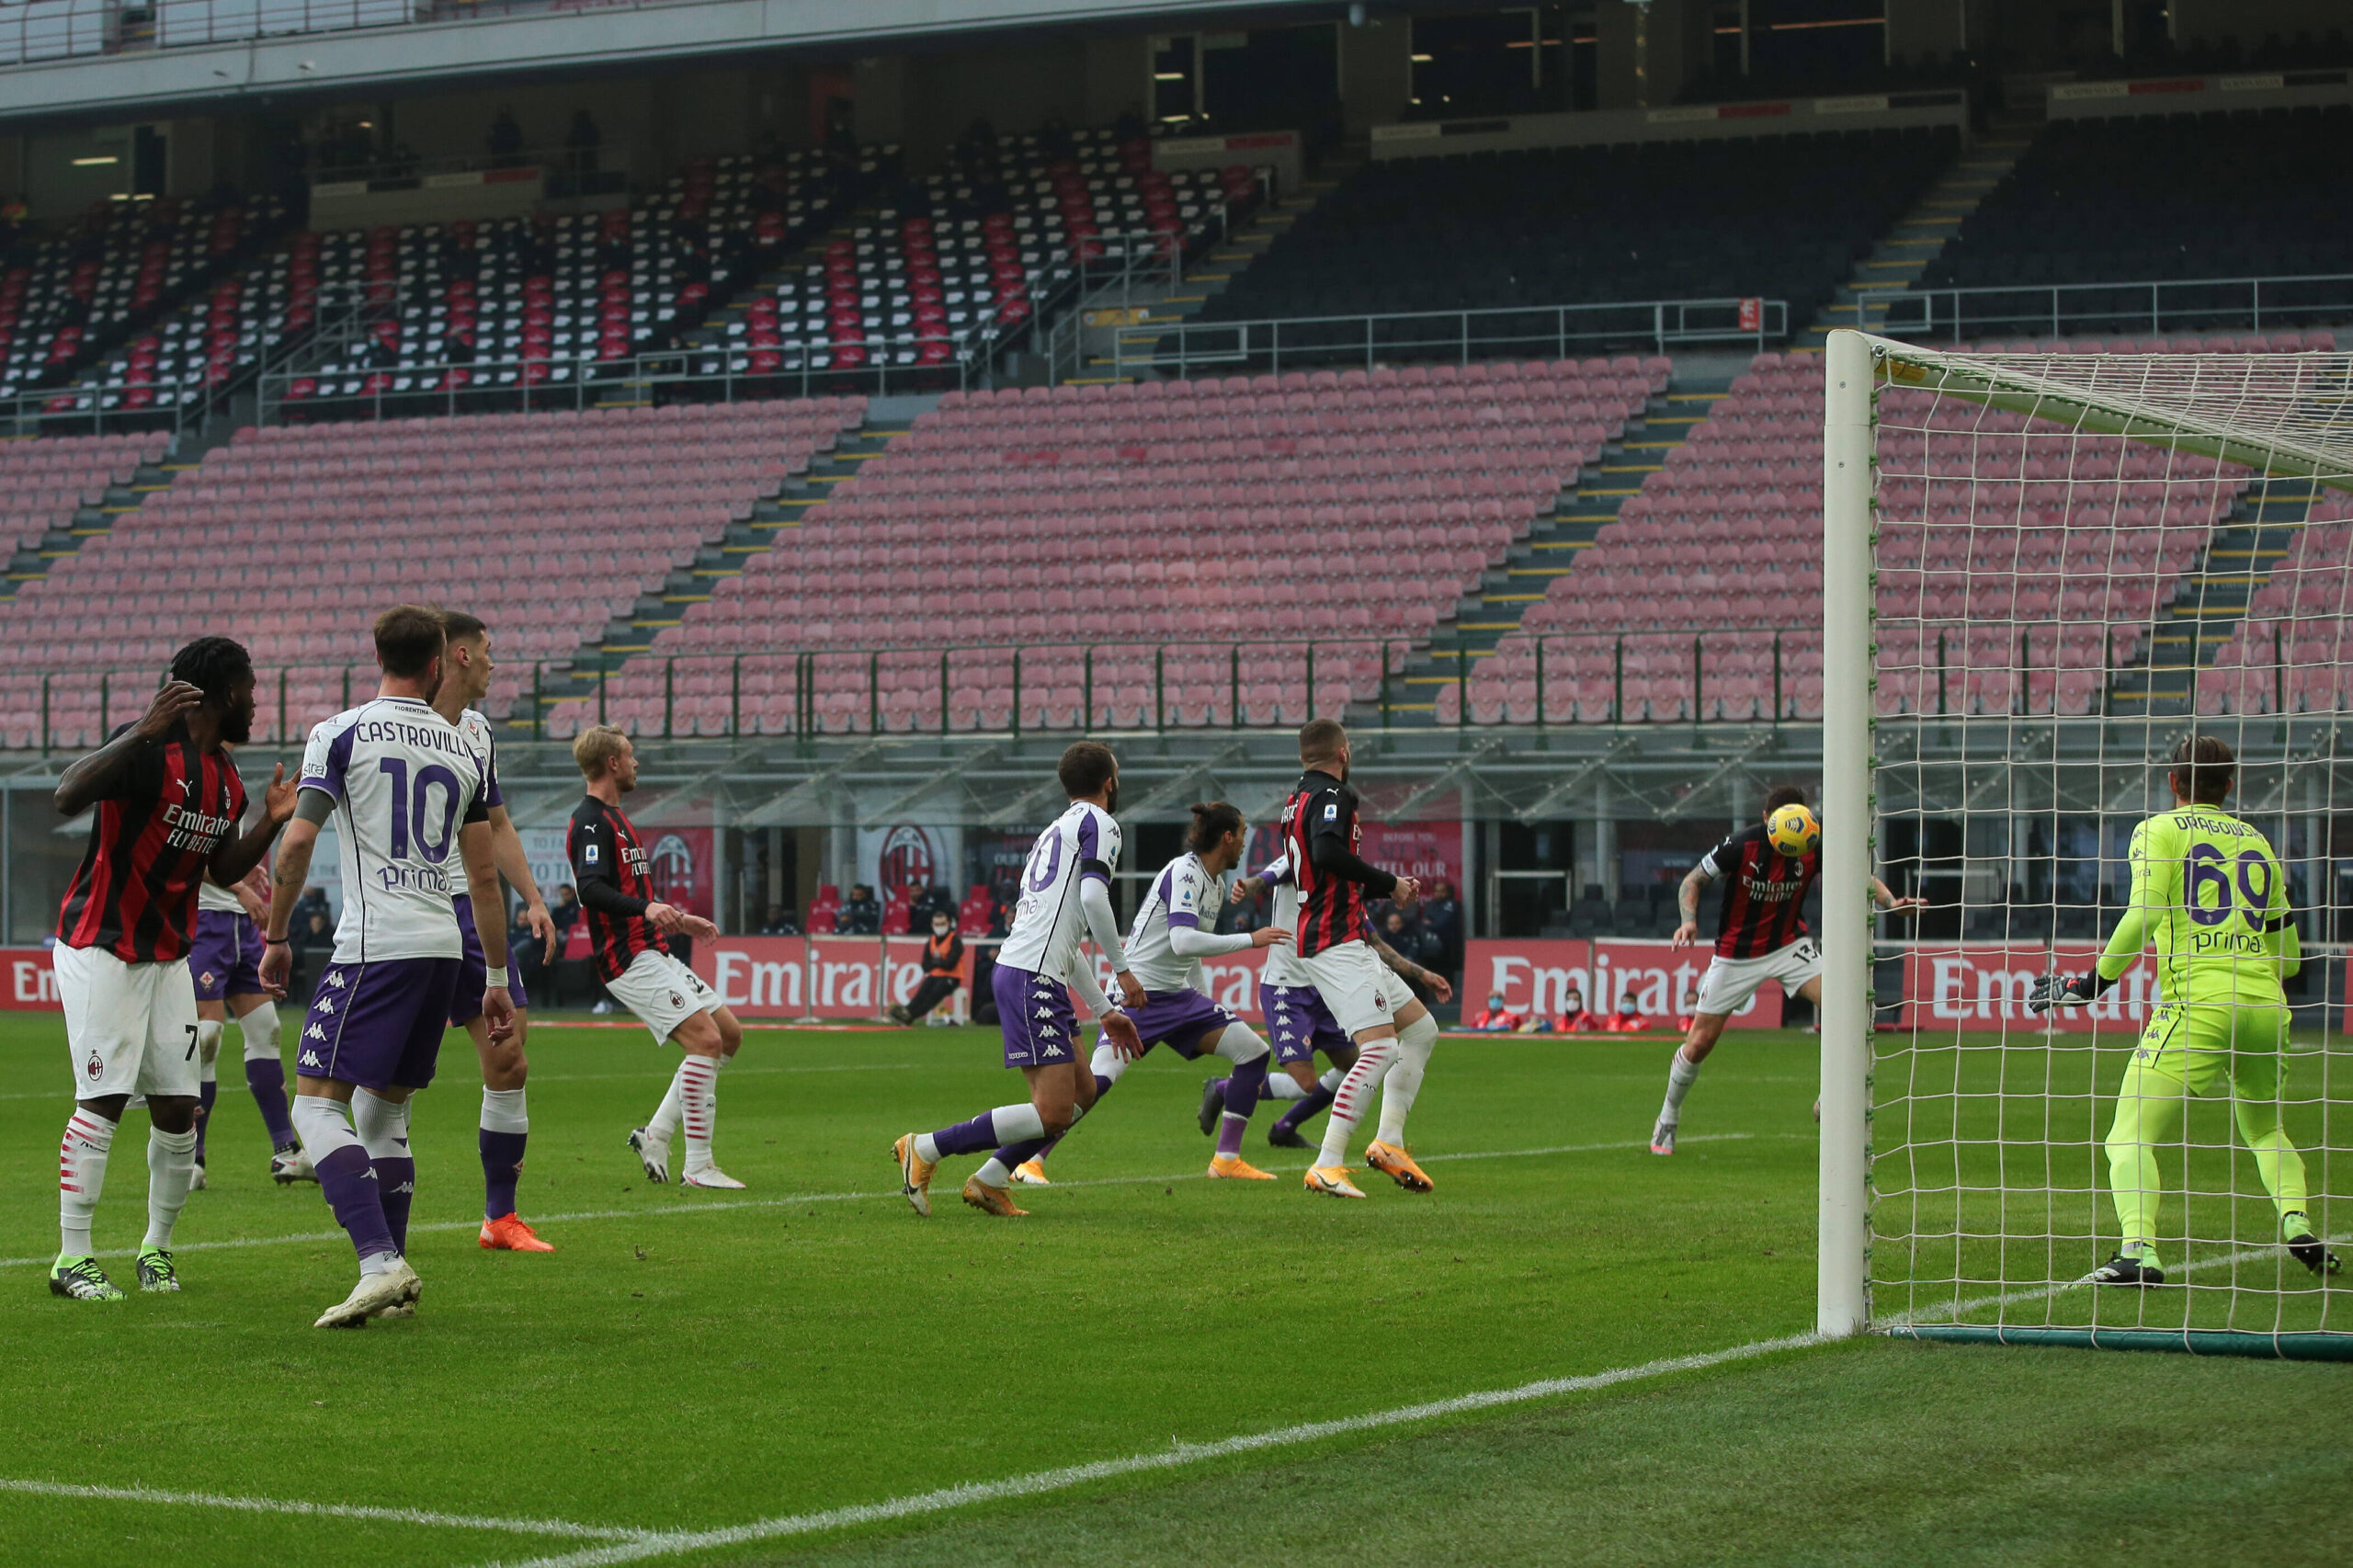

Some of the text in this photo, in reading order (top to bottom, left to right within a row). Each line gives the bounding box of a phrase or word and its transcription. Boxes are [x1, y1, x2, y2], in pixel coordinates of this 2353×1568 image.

[395, 705, 429, 715] FIORENTINA
[301, 762, 324, 778] stra
[163, 802, 231, 835] Emirate
[380, 756, 460, 864] 10
[166, 828, 191, 848] FLY
[1284, 835, 1309, 903] 2
[2183, 842, 2271, 933] 69
[714, 949, 925, 1007] Emirate
[1491, 953, 1756, 1016] Emirat
[185, 1024, 199, 1062] 7
